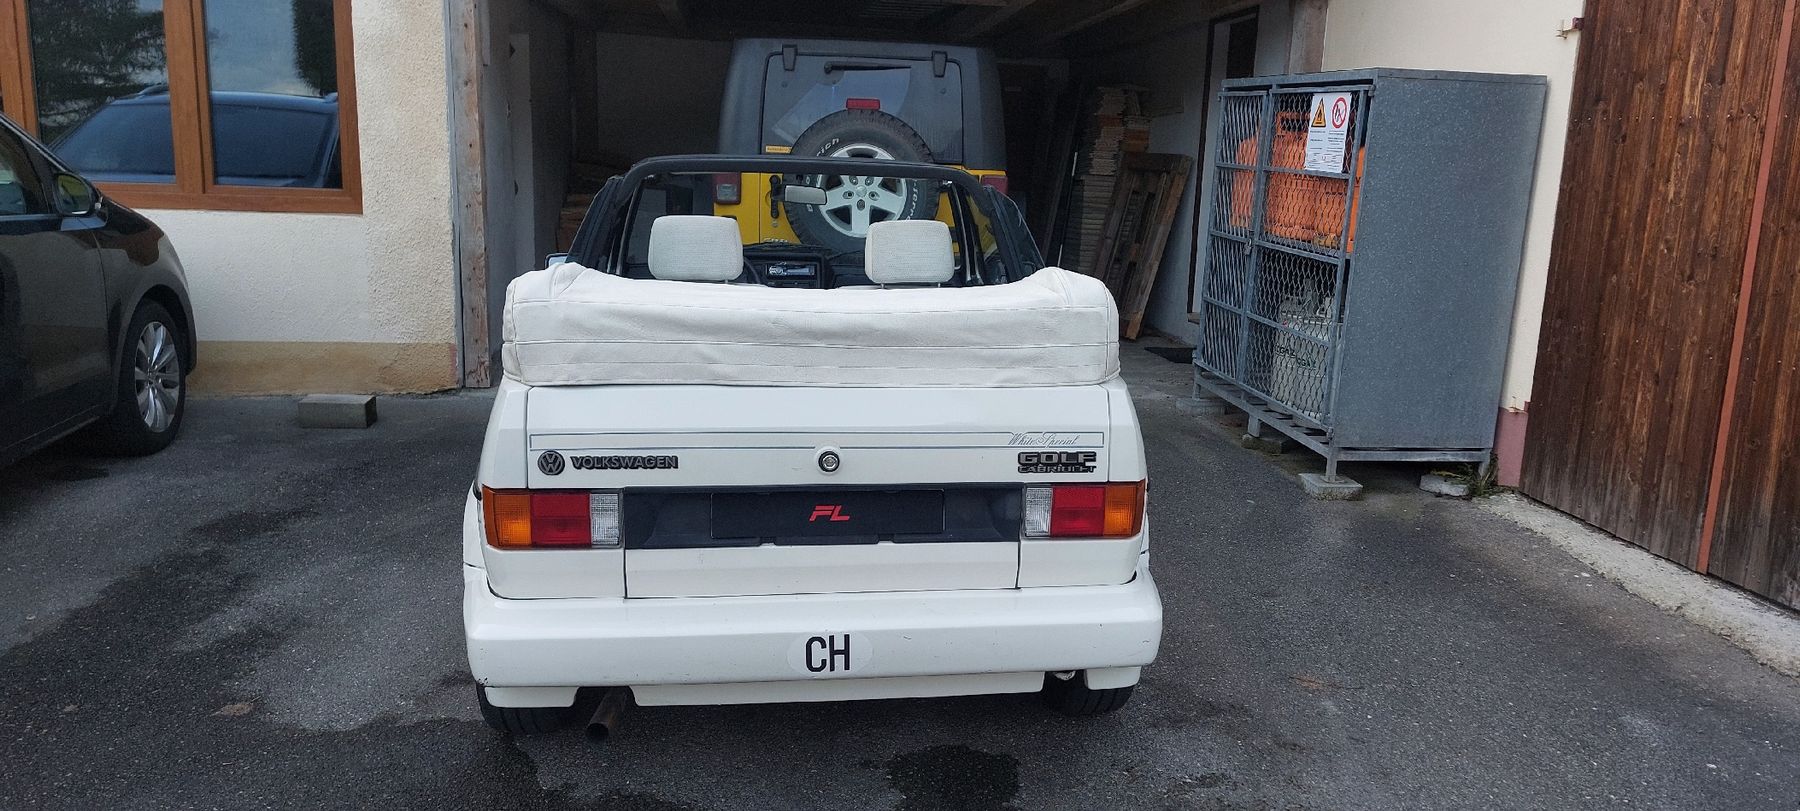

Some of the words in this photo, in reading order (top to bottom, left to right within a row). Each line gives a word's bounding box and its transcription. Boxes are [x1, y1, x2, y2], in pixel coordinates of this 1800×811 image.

[570, 455, 679, 470] VOLKSWAGEN
[1018, 451, 1097, 465] GOLF
[809, 505, 850, 522] FL
[805, 633, 850, 673] CH
